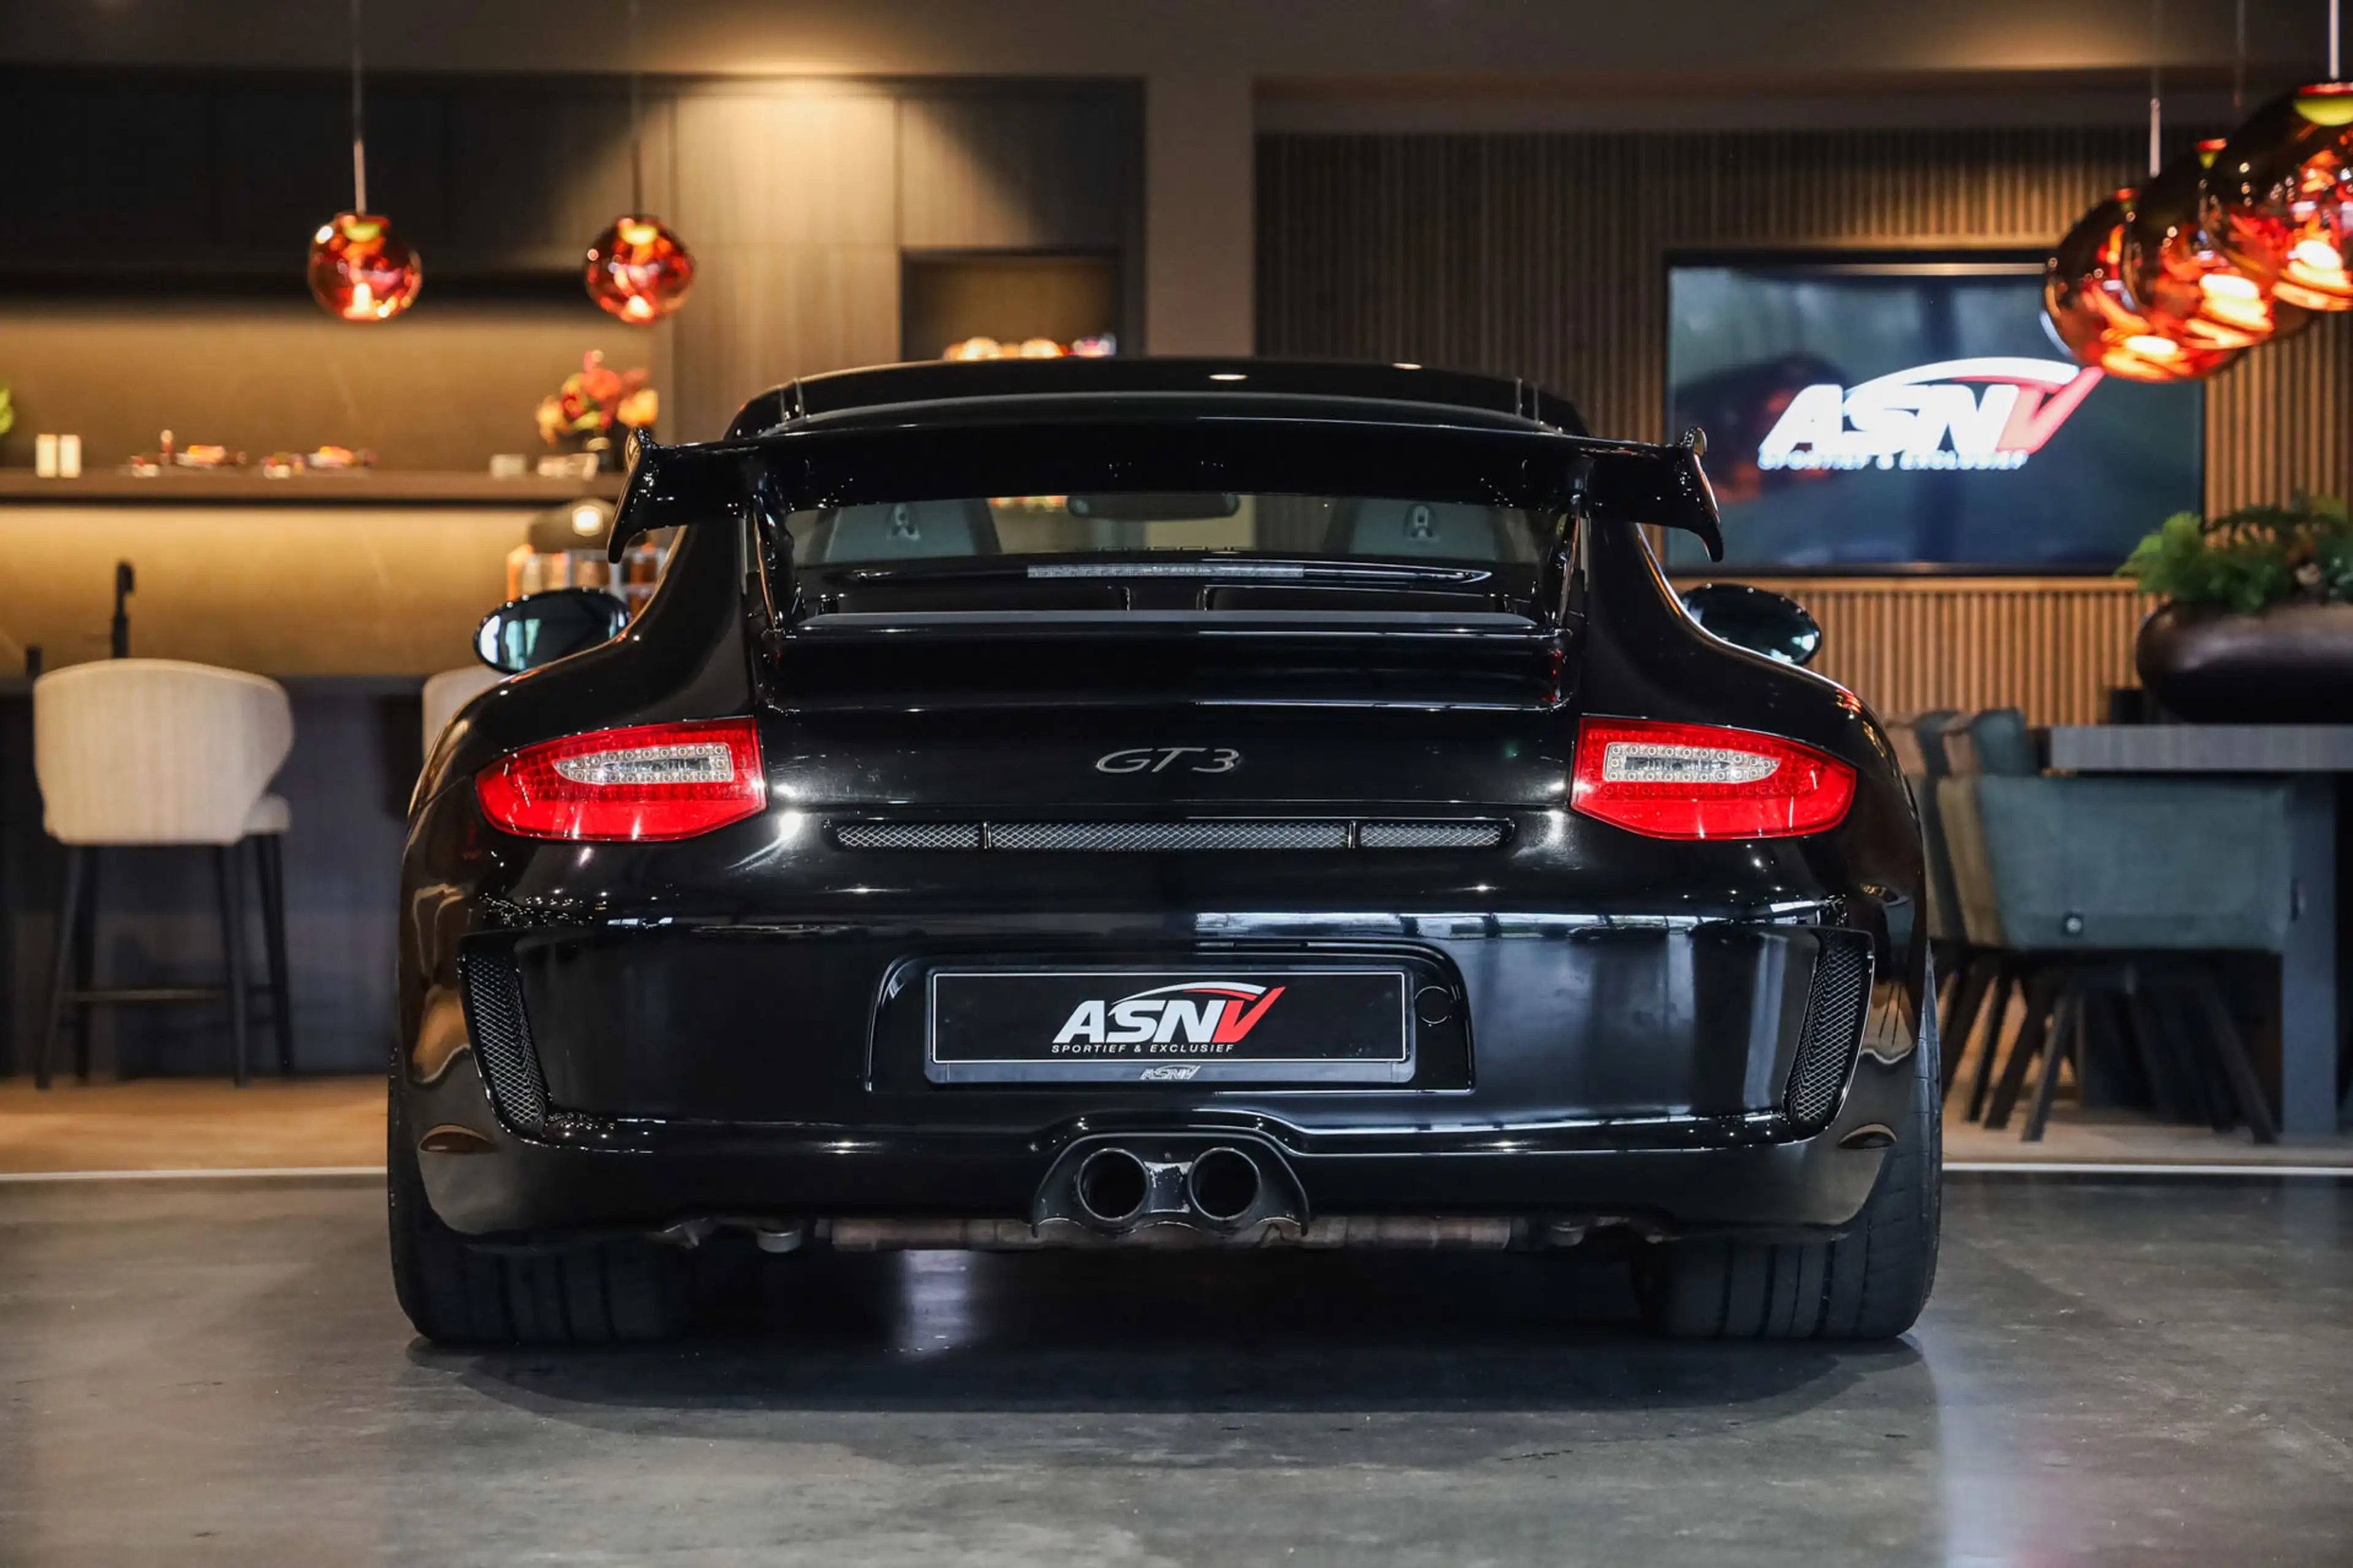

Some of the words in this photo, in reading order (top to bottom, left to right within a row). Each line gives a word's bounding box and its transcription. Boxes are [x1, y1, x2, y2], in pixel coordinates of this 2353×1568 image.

[1759, 364, 2106, 453] ASNV
[1095, 748, 1240, 773] GT3
[1052, 985, 1286, 1043] ASNV
[1051, 1044, 1126, 1053] SPORTIEF
[1134, 1044, 1142, 1053] &
[1150, 1044, 1235, 1053] EXCLUSIEF
